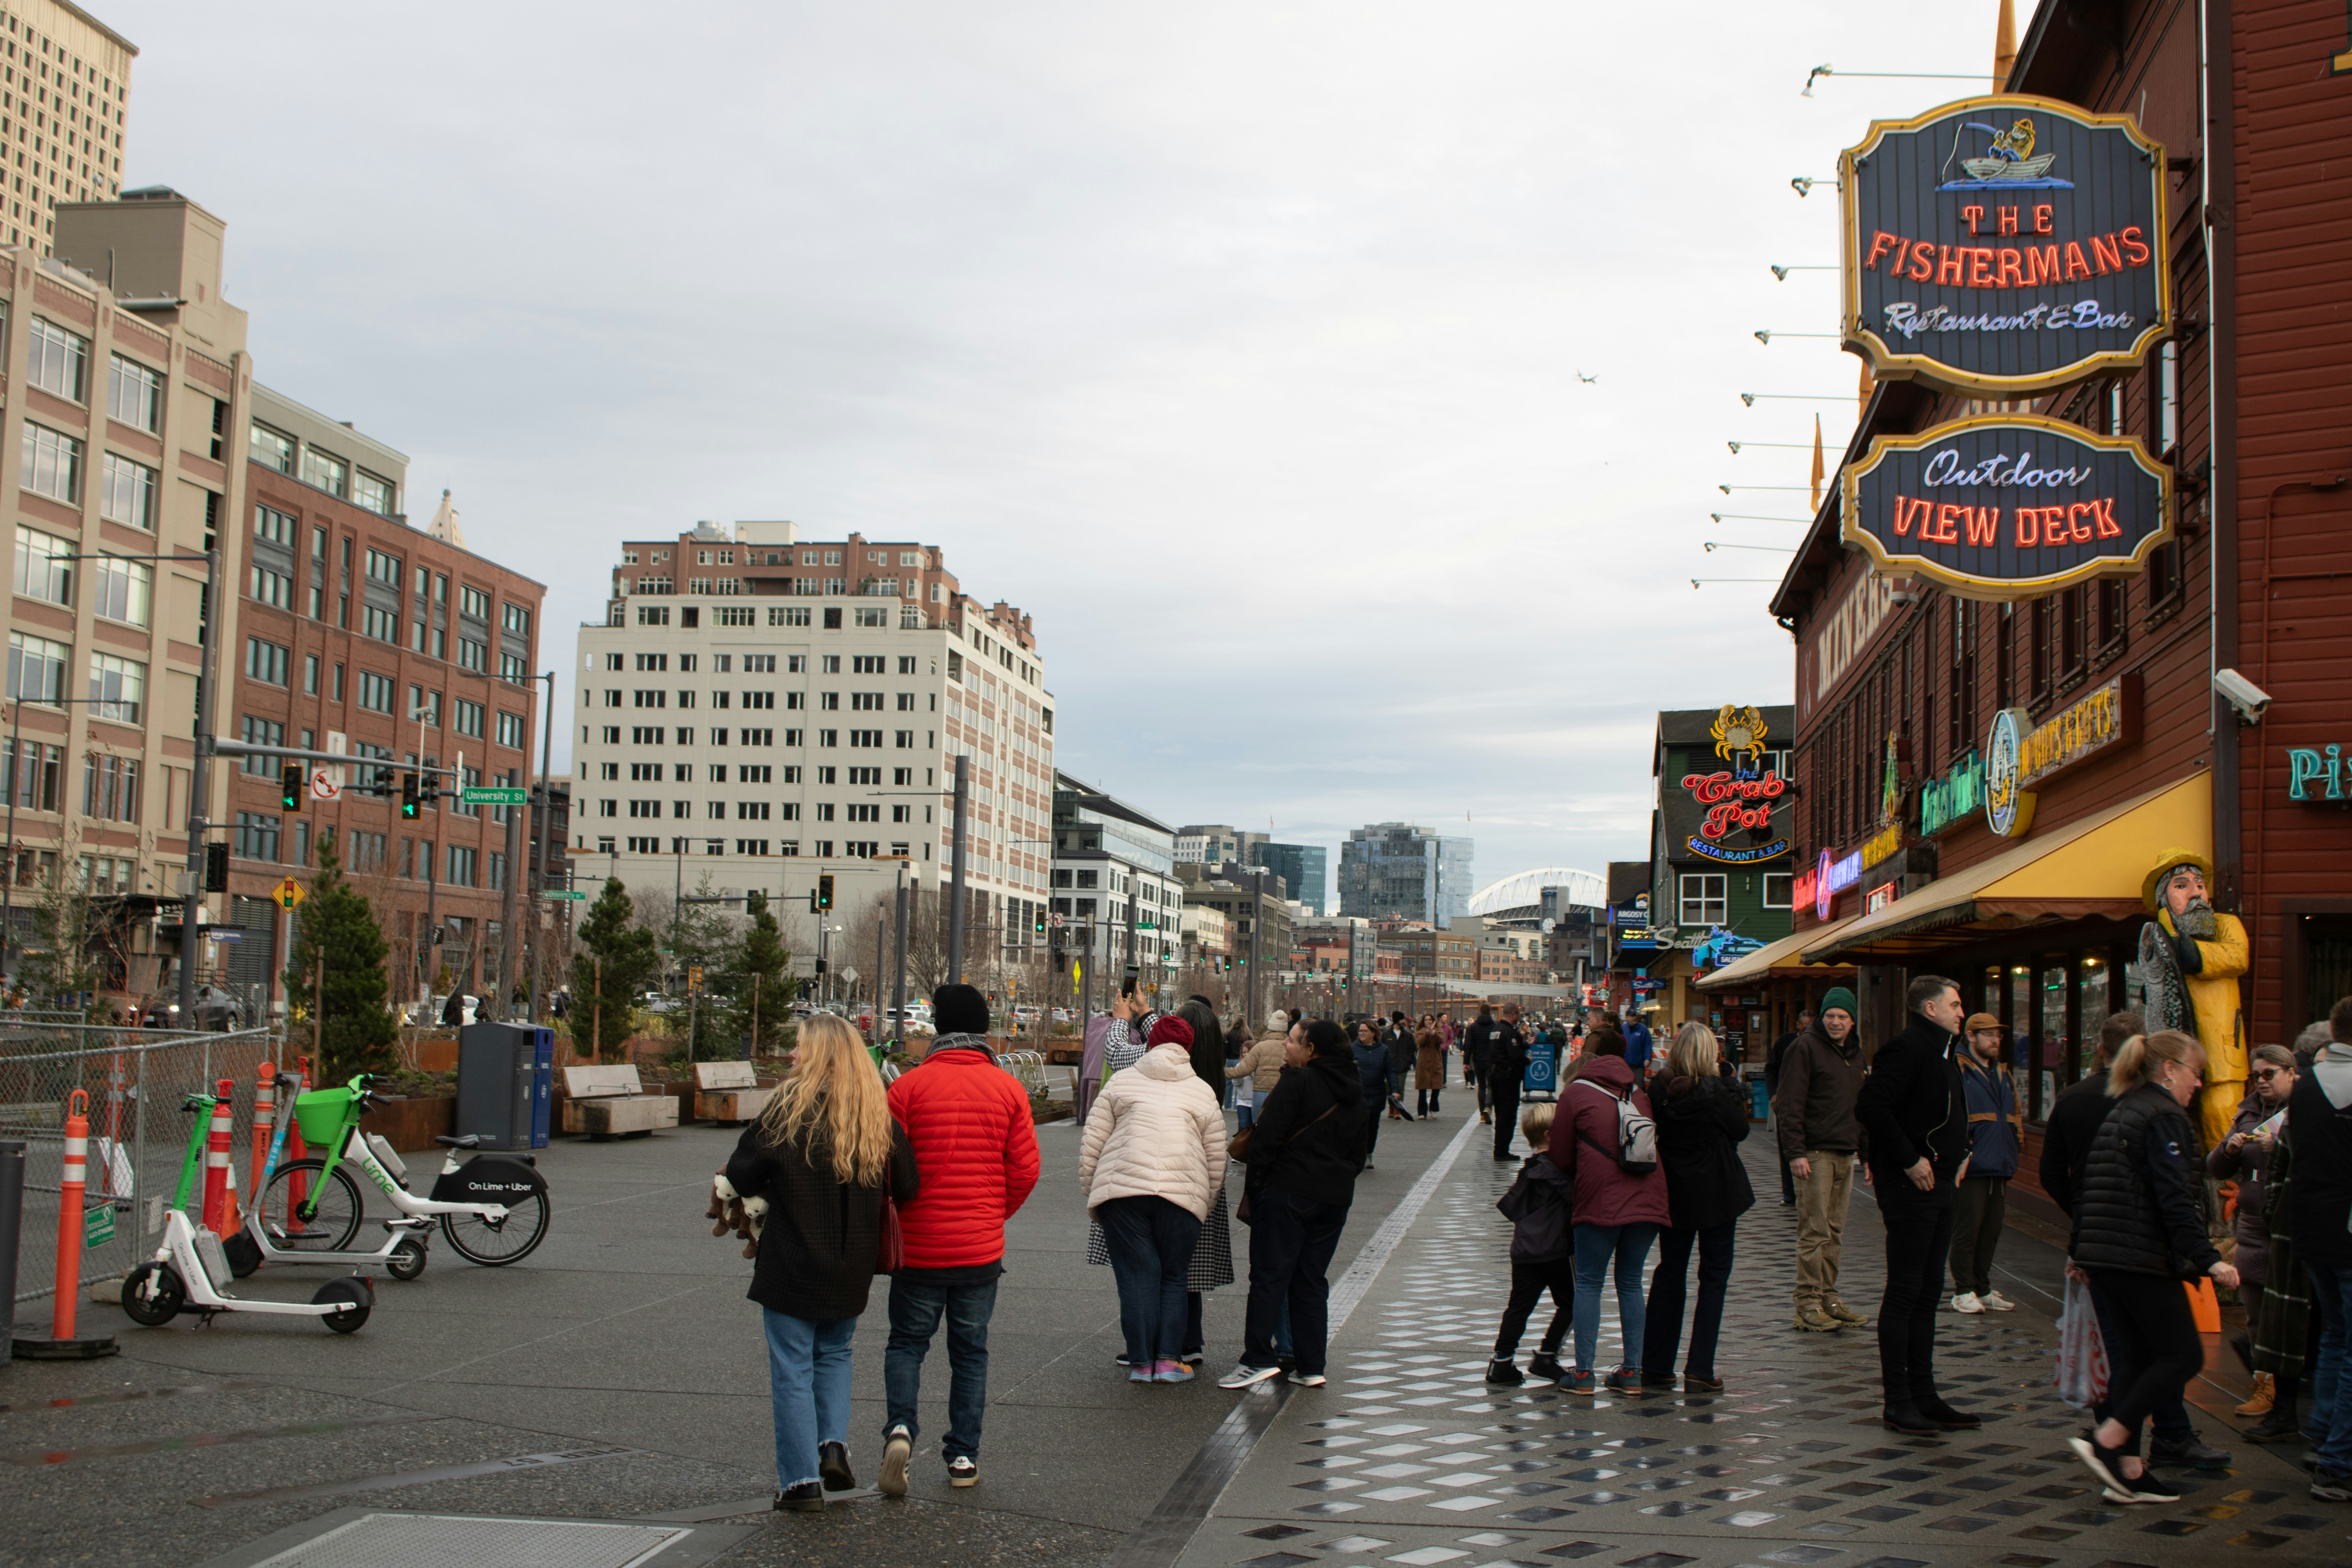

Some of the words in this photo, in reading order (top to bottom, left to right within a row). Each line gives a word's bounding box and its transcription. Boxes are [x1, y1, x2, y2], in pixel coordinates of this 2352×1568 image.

[1962, 204, 2053, 237] THE
[1863, 226, 2151, 289] FISHERMANS
[1884, 301, 2049, 340] Restaurant
[2070, 299, 2136, 329] Bar
[1924, 449, 2091, 488] Outdoor
[1893, 494, 2000, 547] VIEW
[2014, 497, 2123, 548] DECK
[1681, 769, 1786, 804] Crab
[1736, 768, 1759, 780] the
[2286, 743, 2352, 801] Pi
[466, 791, 509, 802] University
[514, 793, 523, 801] St
[1700, 800, 1771, 840] Pot
[1689, 838, 1757, 861] RESTAURANT
[1758, 849, 1765, 858] &
[1765, 841, 1788, 856] BAR
[267, 1139, 281, 1167] BIRD
[362, 1156, 395, 1195] Lime
[468, 1181, 482, 1190] On
[483, 1182, 504, 1191] Lime
[511, 1182, 532, 1191] Uber
